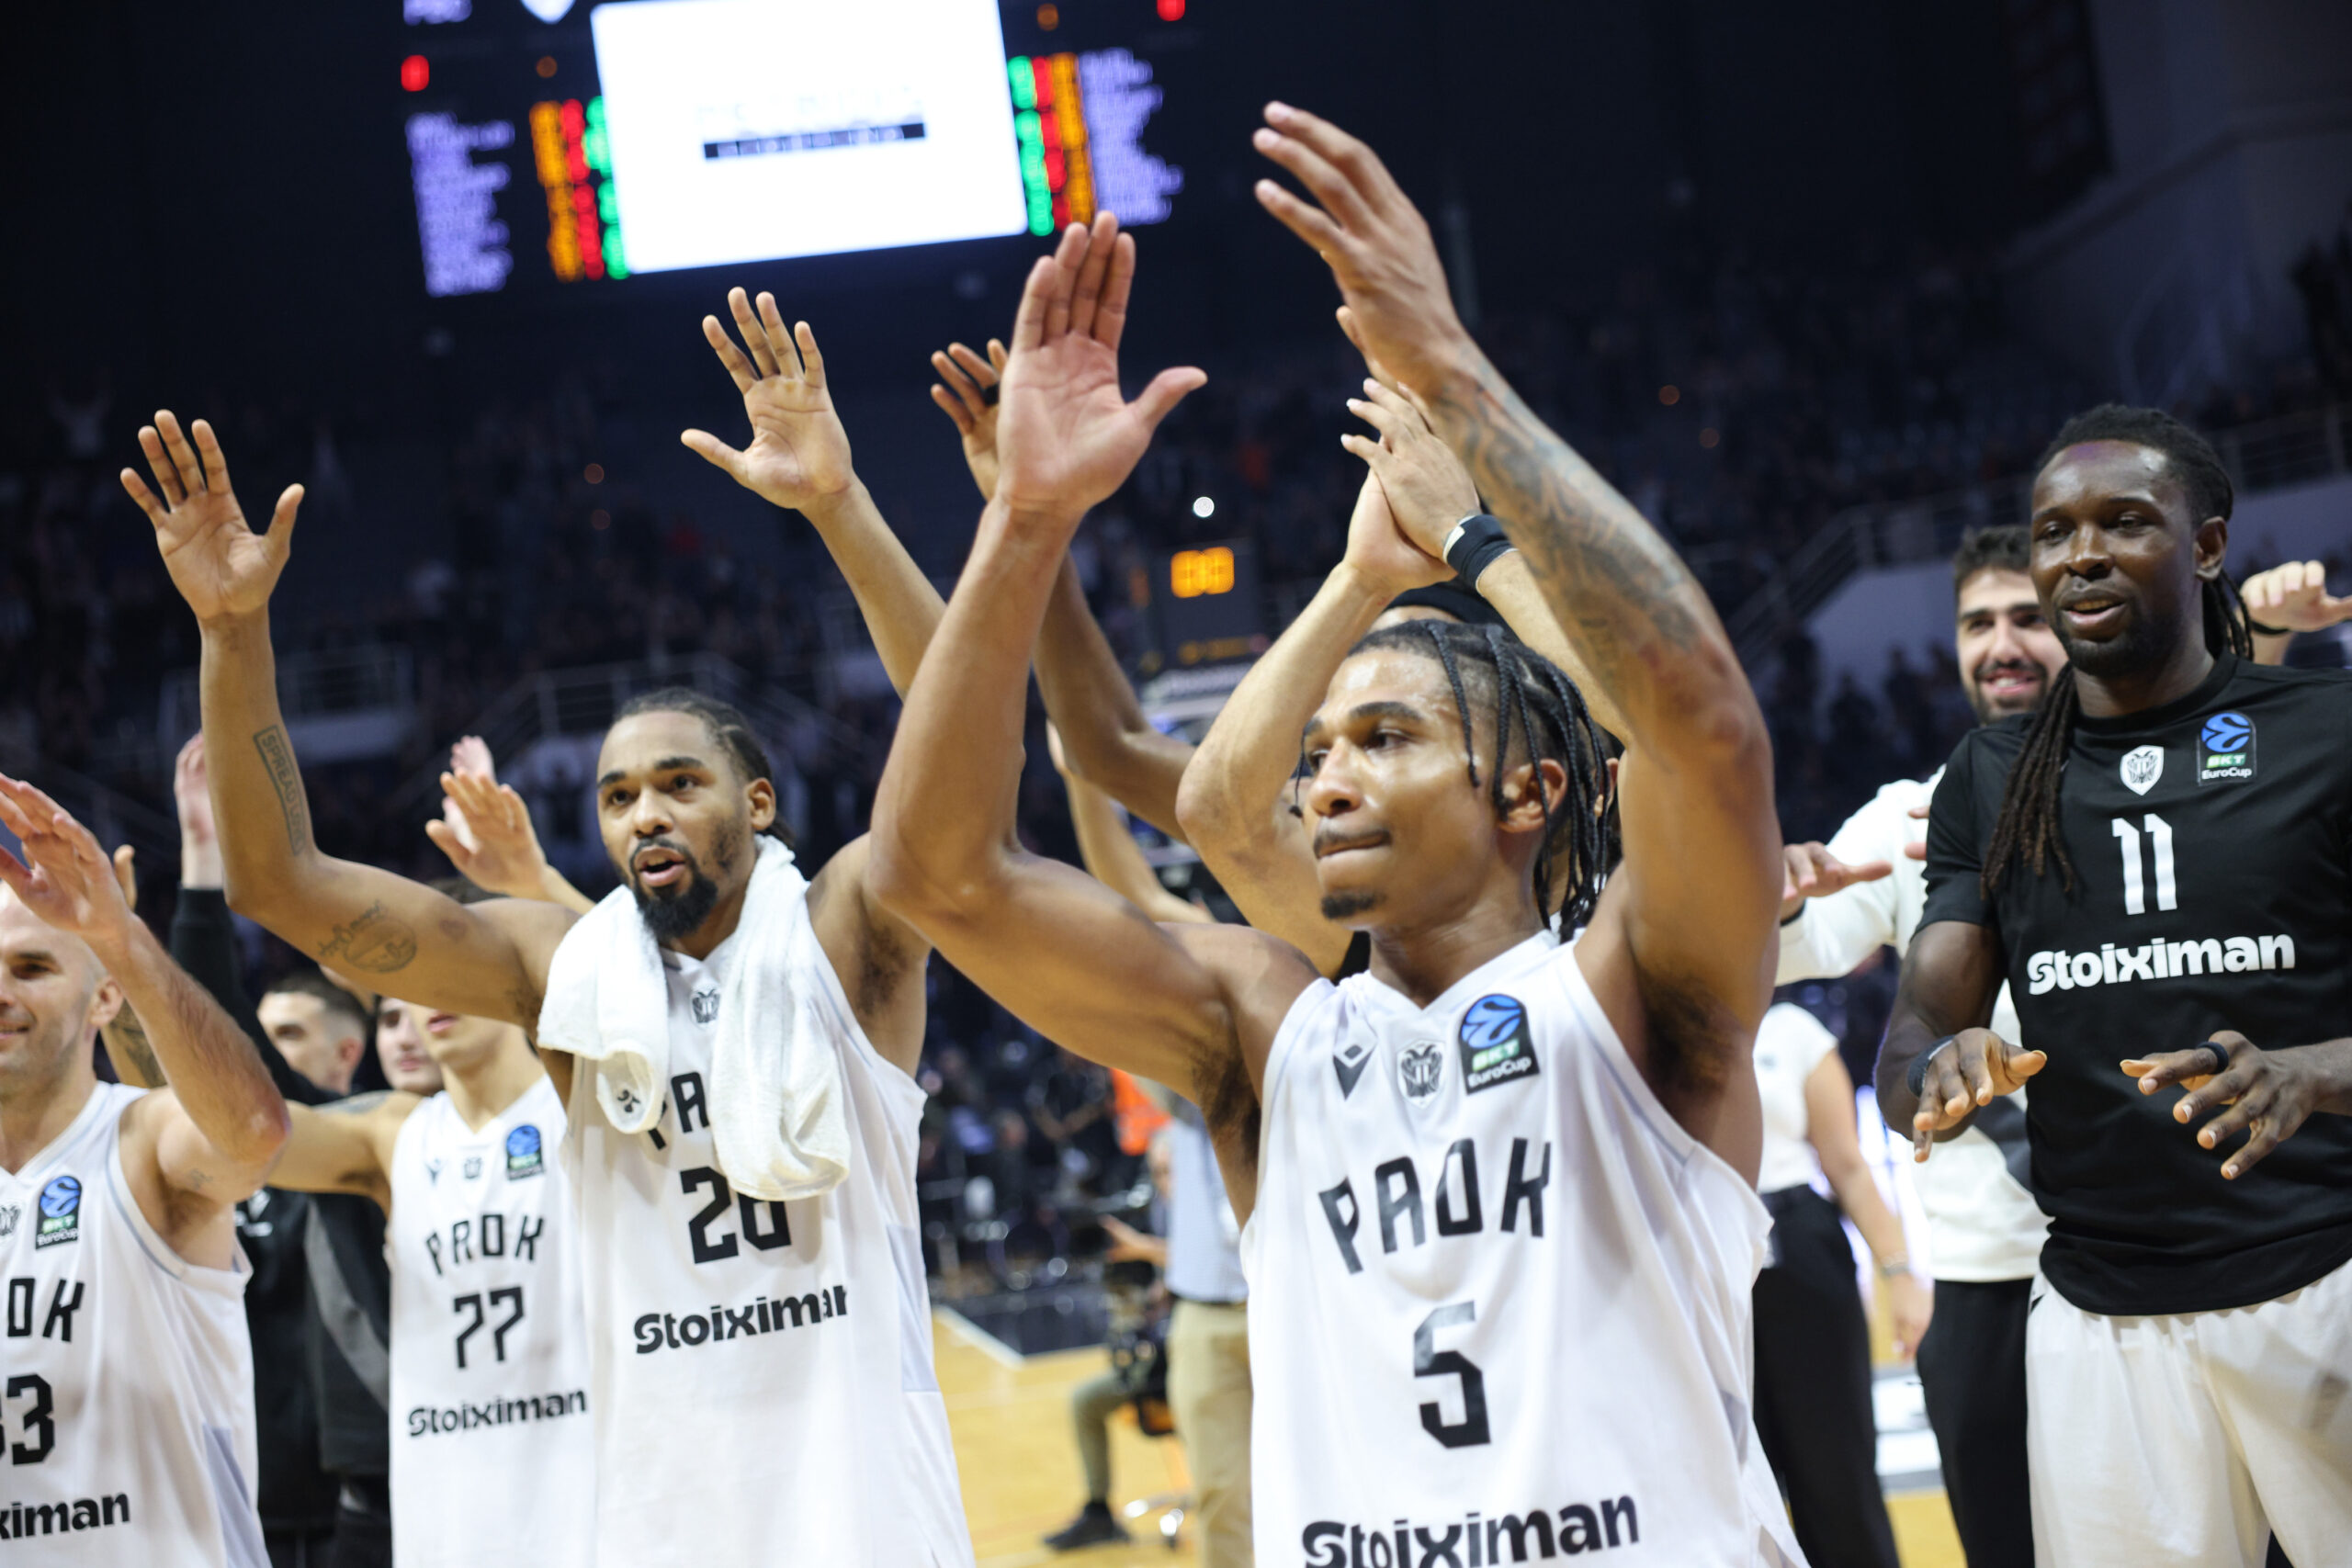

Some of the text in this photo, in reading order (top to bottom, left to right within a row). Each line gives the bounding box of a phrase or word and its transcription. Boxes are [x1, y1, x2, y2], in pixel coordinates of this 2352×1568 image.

[2201, 767, 2253, 780] EuroCup
[2112, 813, 2177, 915] 11
[2027, 933, 2295, 996] Stoiximan
[1467, 1056, 1532, 1089] EuroCup
[1318, 1137, 1552, 1276] PAOK
[426, 1214, 544, 1276] PAOK
[453, 1286, 524, 1369] 77
[1413, 1300, 1491, 1450] 5
[0, 1372, 55, 1466] 3
[409, 1389, 586, 1437] Stoiximan
[1302, 1494, 1640, 1568] Stoiximan
